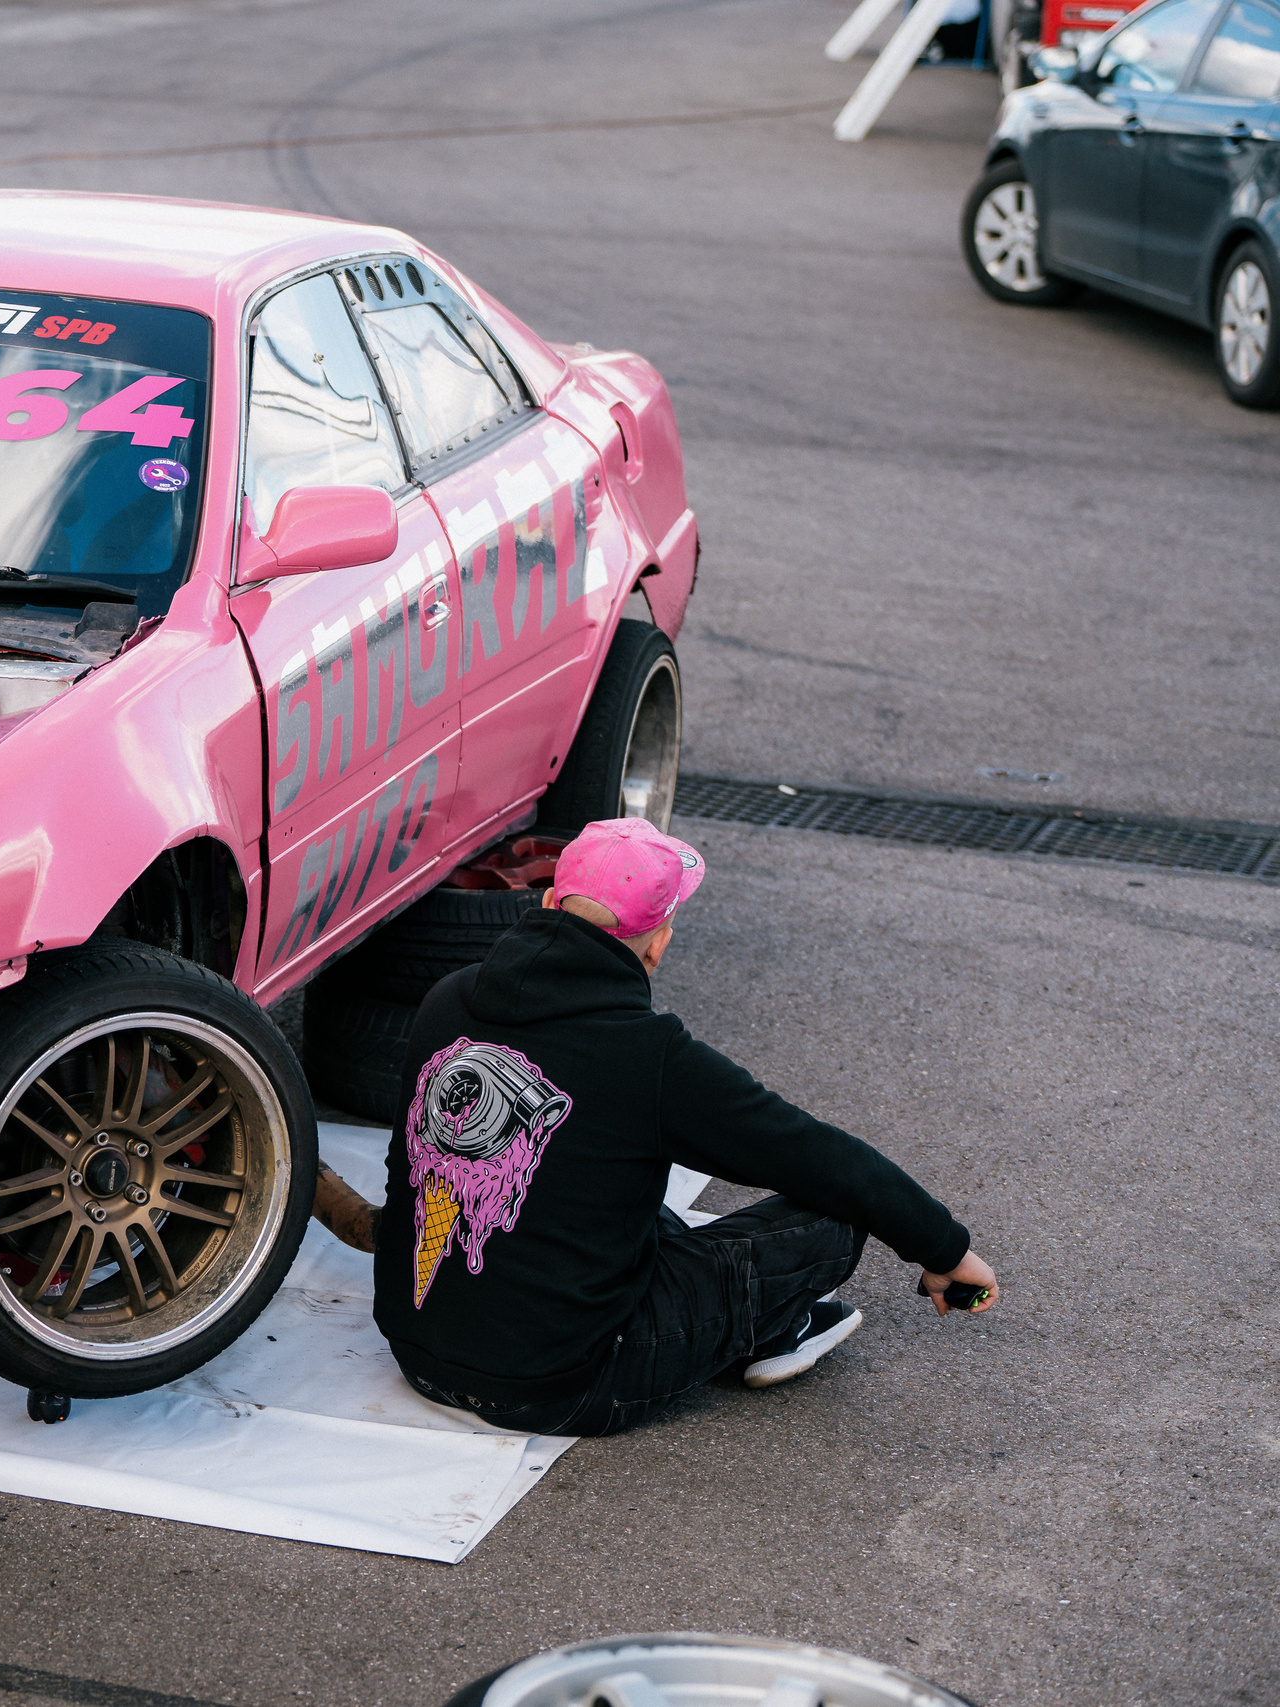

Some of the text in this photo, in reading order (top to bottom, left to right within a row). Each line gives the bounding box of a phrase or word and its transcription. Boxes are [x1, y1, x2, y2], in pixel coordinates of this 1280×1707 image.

[33, 315, 117, 345] SPB
[274, 427, 609, 816] SAMURAI
[270, 754, 439, 968] AUTO
